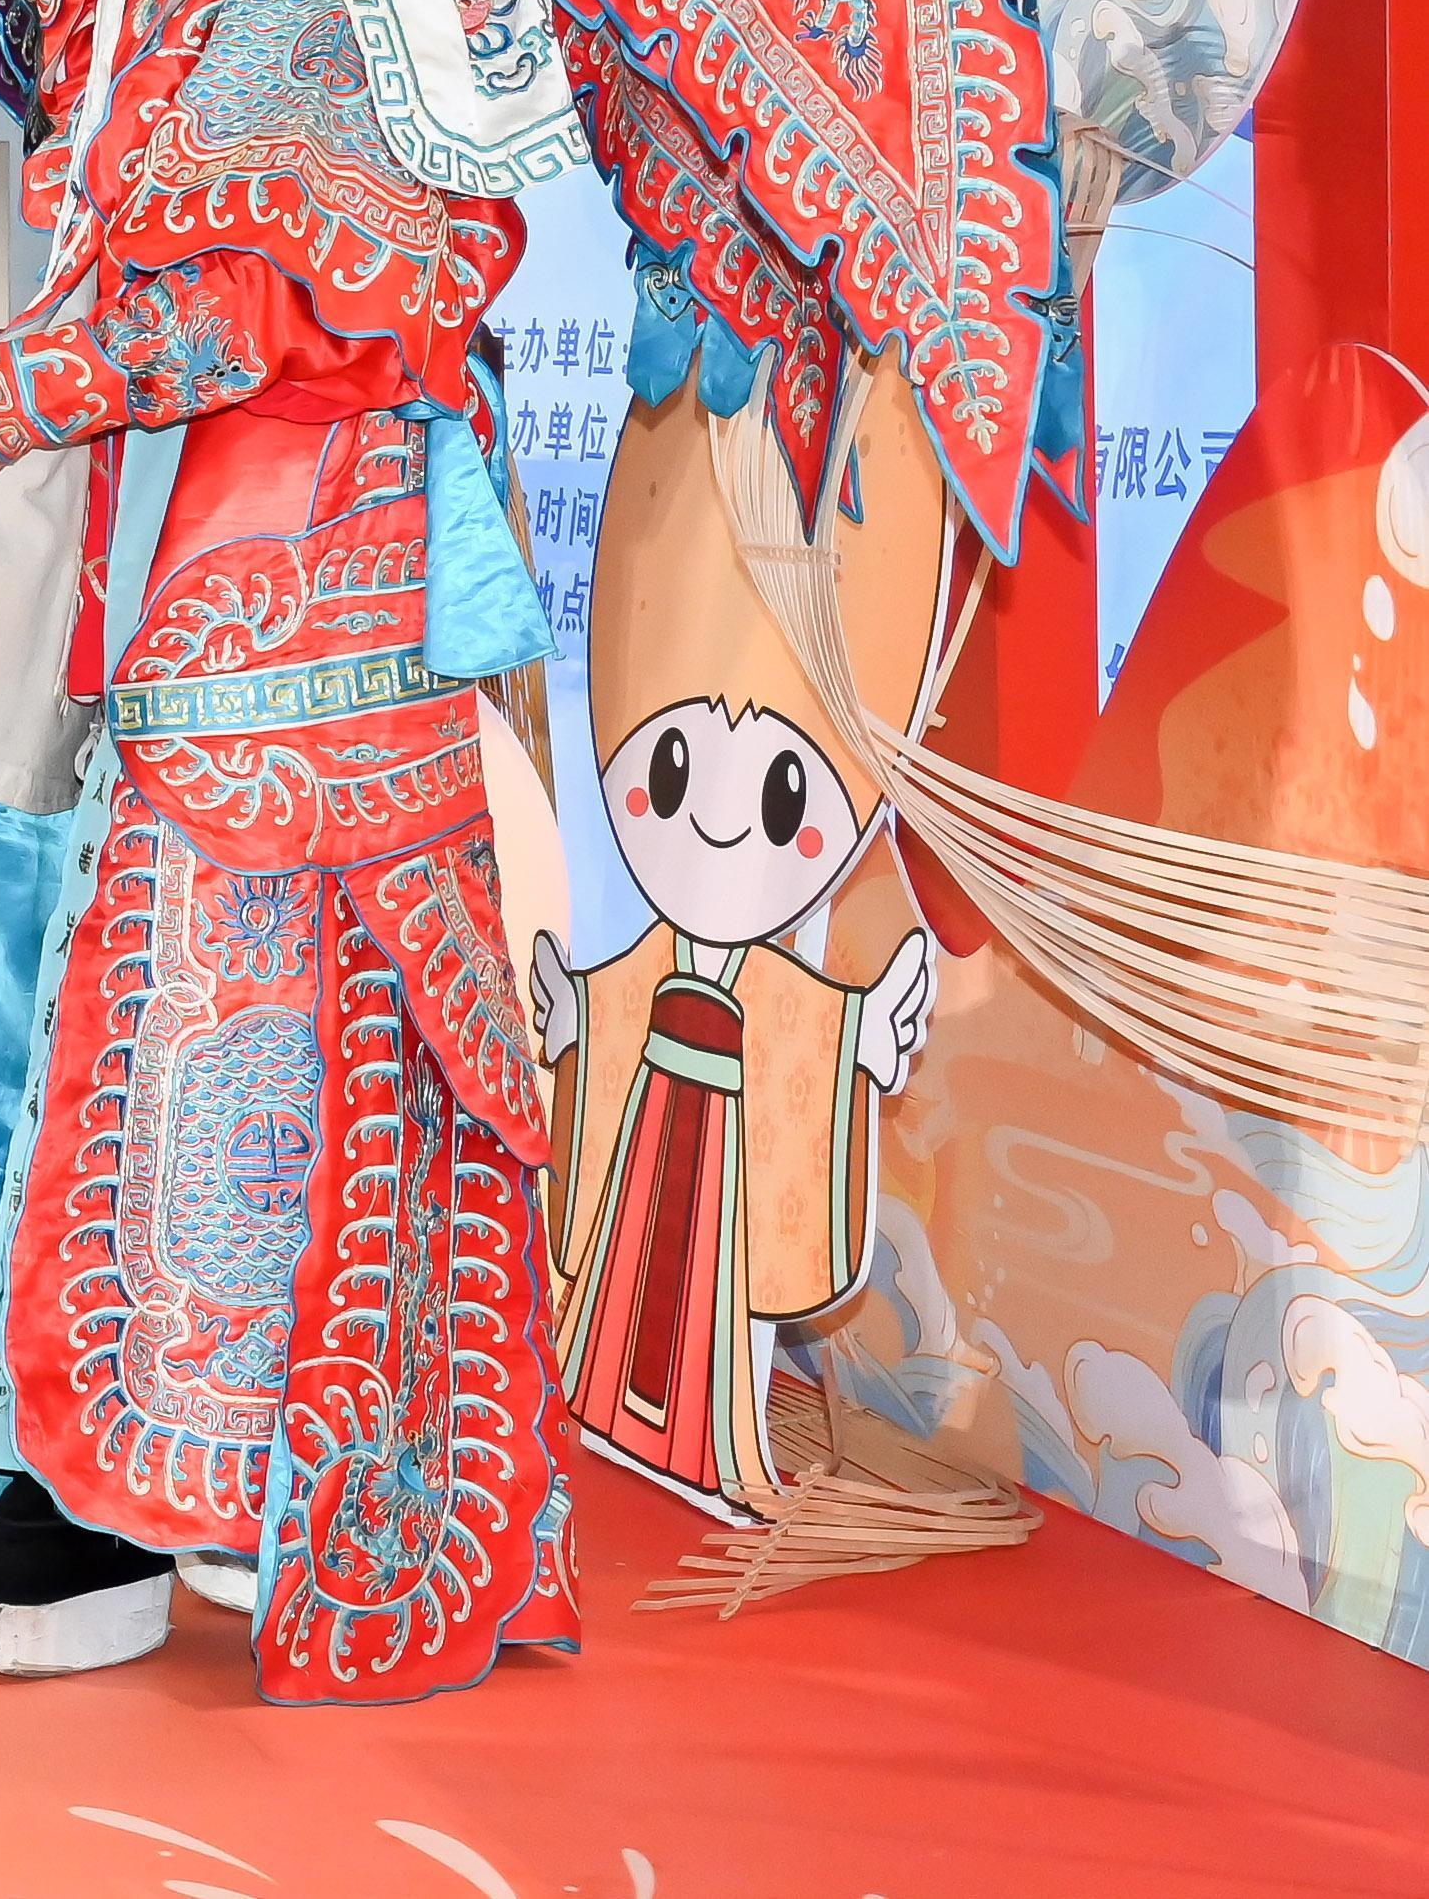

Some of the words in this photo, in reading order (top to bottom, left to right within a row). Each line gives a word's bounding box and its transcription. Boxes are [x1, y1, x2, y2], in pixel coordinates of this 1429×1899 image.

[514, 400, 609, 462] 办单位
[524, 488, 599, 548] 时间
